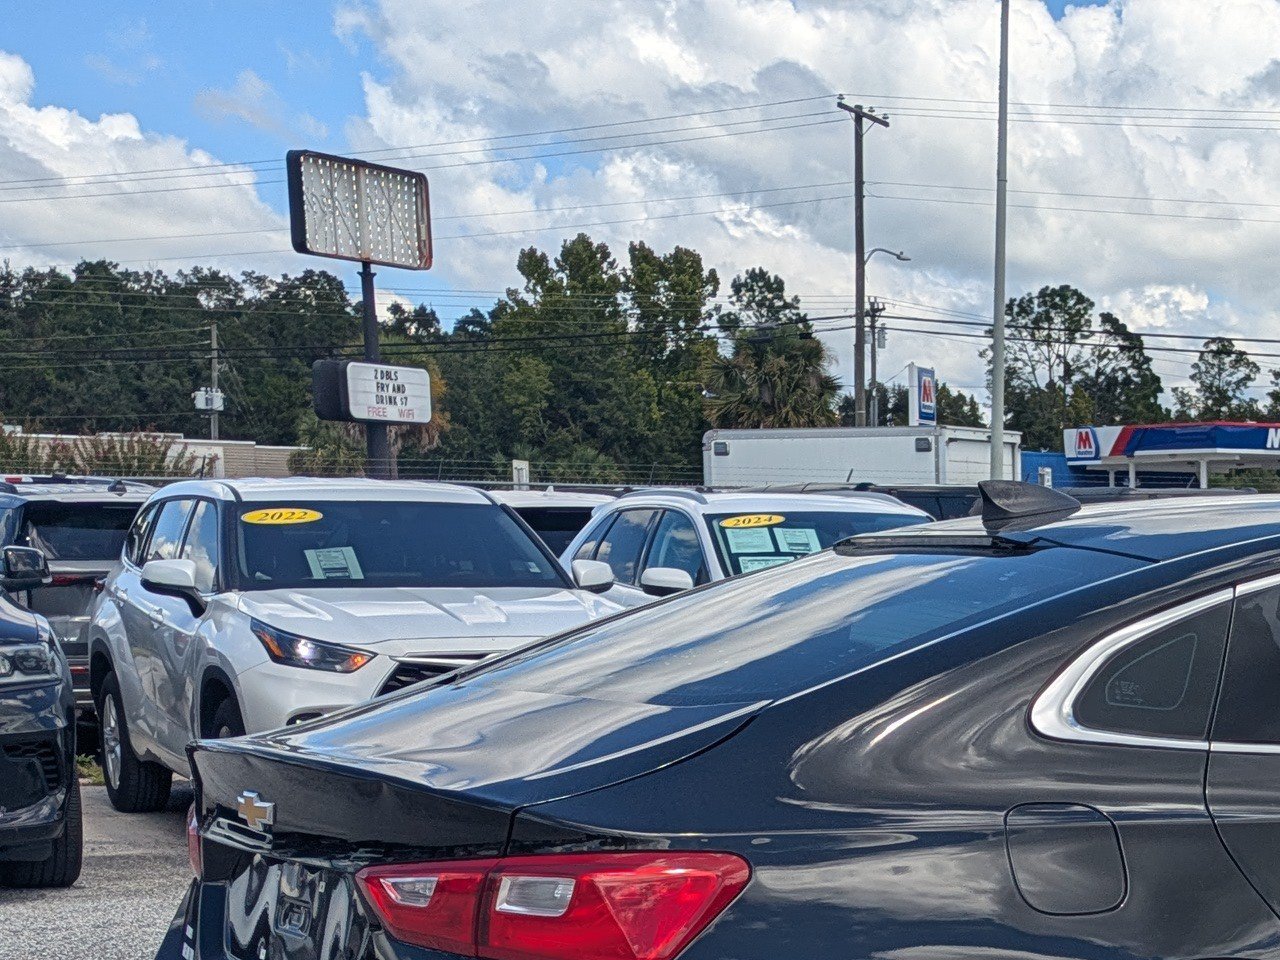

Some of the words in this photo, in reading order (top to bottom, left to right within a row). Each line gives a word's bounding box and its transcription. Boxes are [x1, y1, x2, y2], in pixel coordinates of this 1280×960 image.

[374, 369, 379, 380] 2
[380, 370, 399, 381] DBLS
[376, 382, 390, 393] FRY
[392, 384, 406, 394] AND
[375, 394, 398, 406] DRINK
[367, 406, 388, 418] FREE
[1077, 431, 1093, 449] M
[257, 511, 308, 521] 2022
[733, 516, 773, 527] 2024
